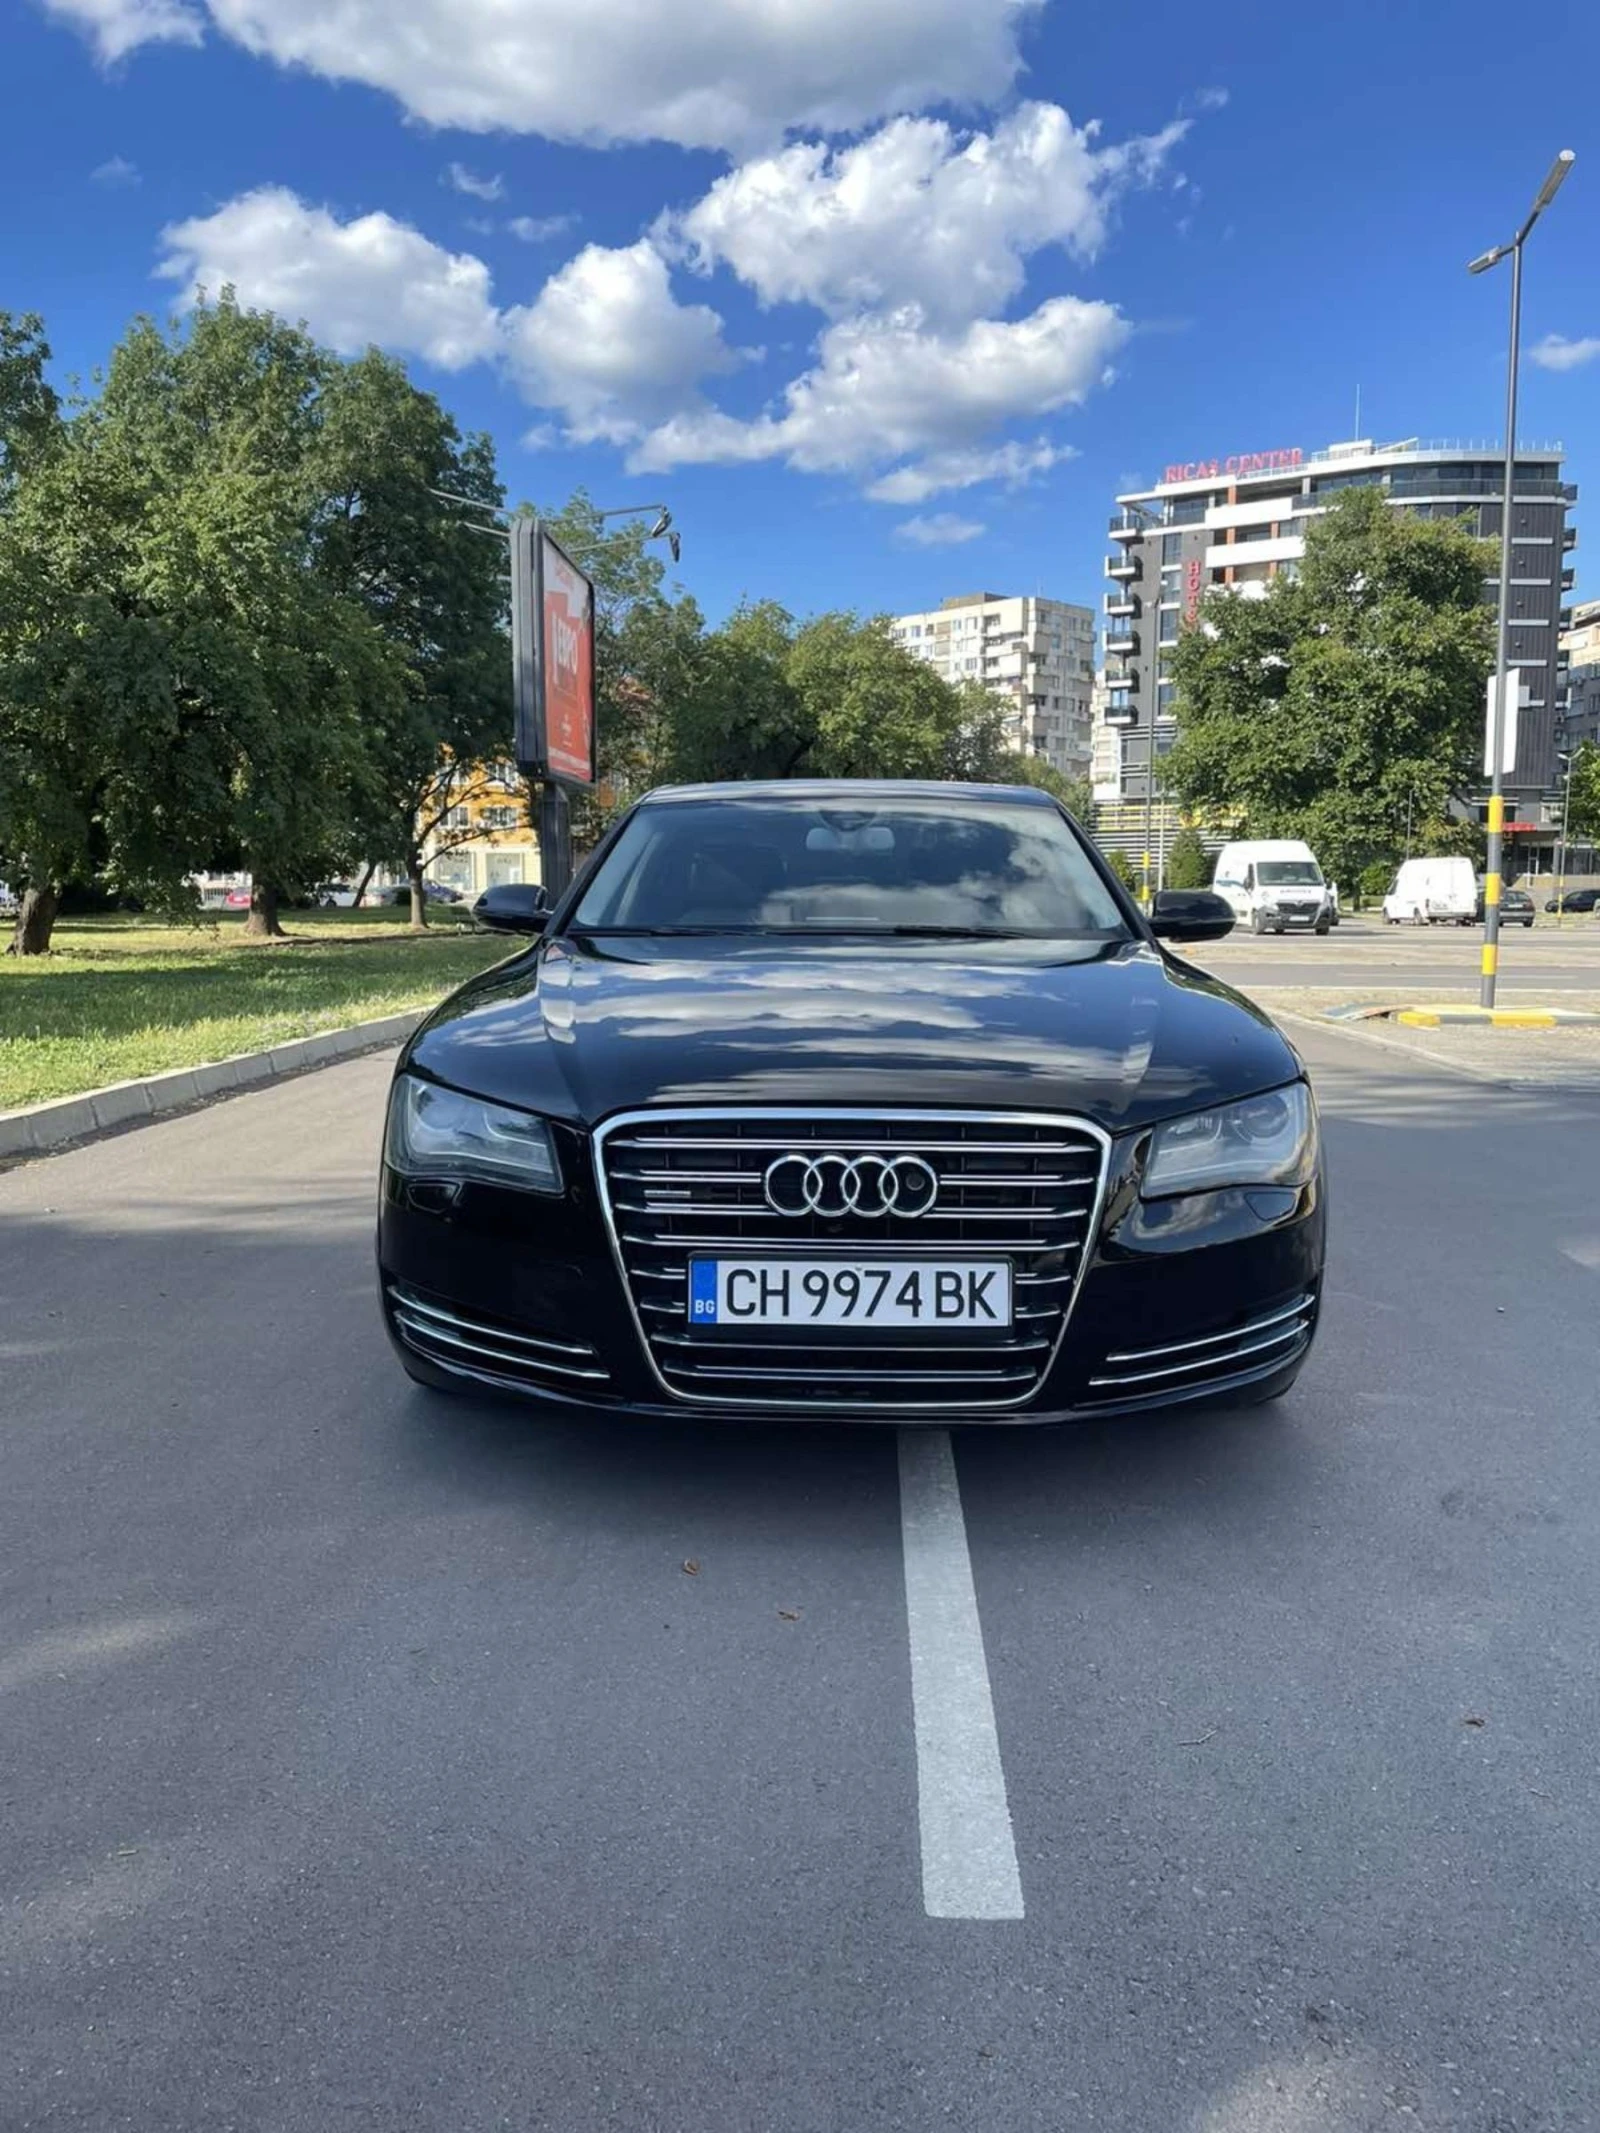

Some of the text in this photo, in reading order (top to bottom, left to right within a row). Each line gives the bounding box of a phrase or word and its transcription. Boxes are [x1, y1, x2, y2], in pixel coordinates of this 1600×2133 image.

[1226, 447, 1302, 475] CENTER
[694, 1300, 715, 1314] BG
[726, 1268, 998, 1319] CH 9974 BK
